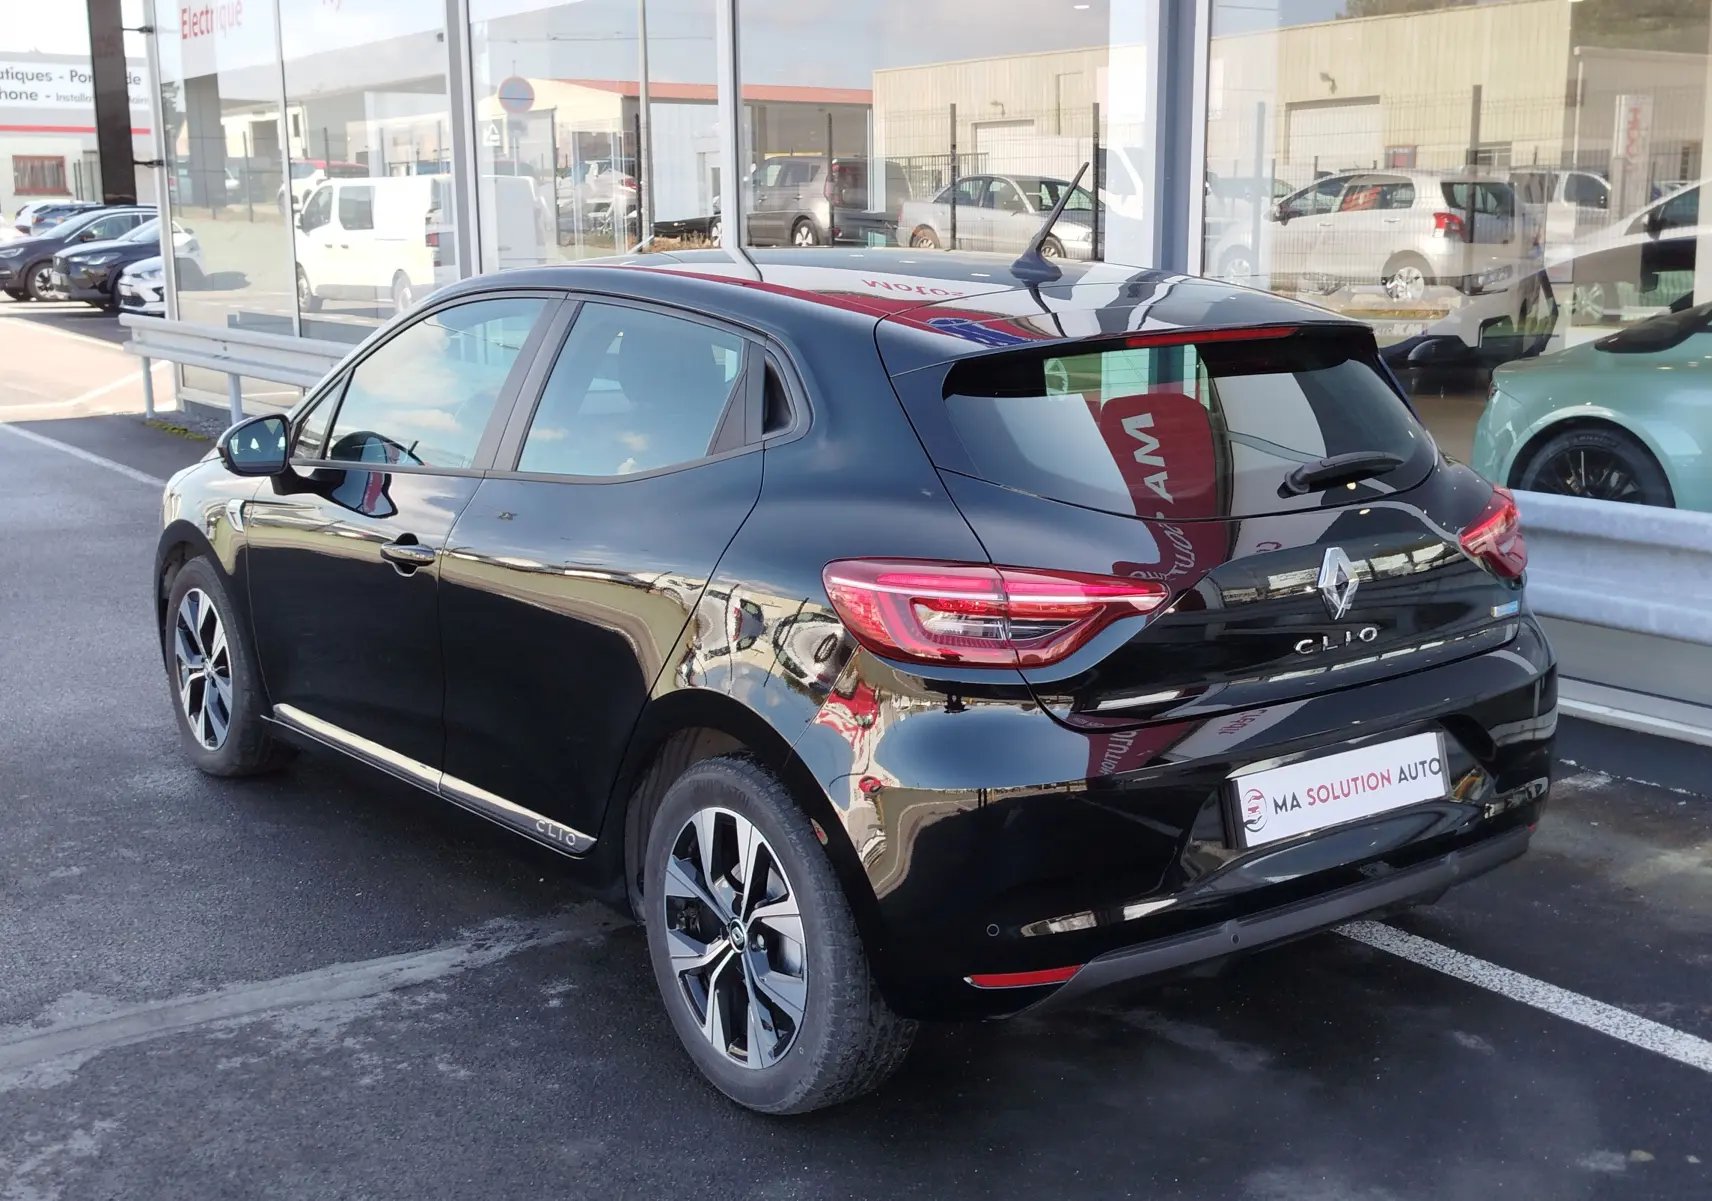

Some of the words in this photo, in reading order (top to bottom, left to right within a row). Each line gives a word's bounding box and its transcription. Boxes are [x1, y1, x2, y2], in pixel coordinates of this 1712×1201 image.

[69, 69, 93, 84] Por
[1295, 626, 1379, 655] CLIO
[1272, 791, 1302, 815] MA
[1306, 768, 1392, 806] SOLUTION
[1398, 757, 1442, 784] AUTO
[535, 820, 576, 846] CLIO
